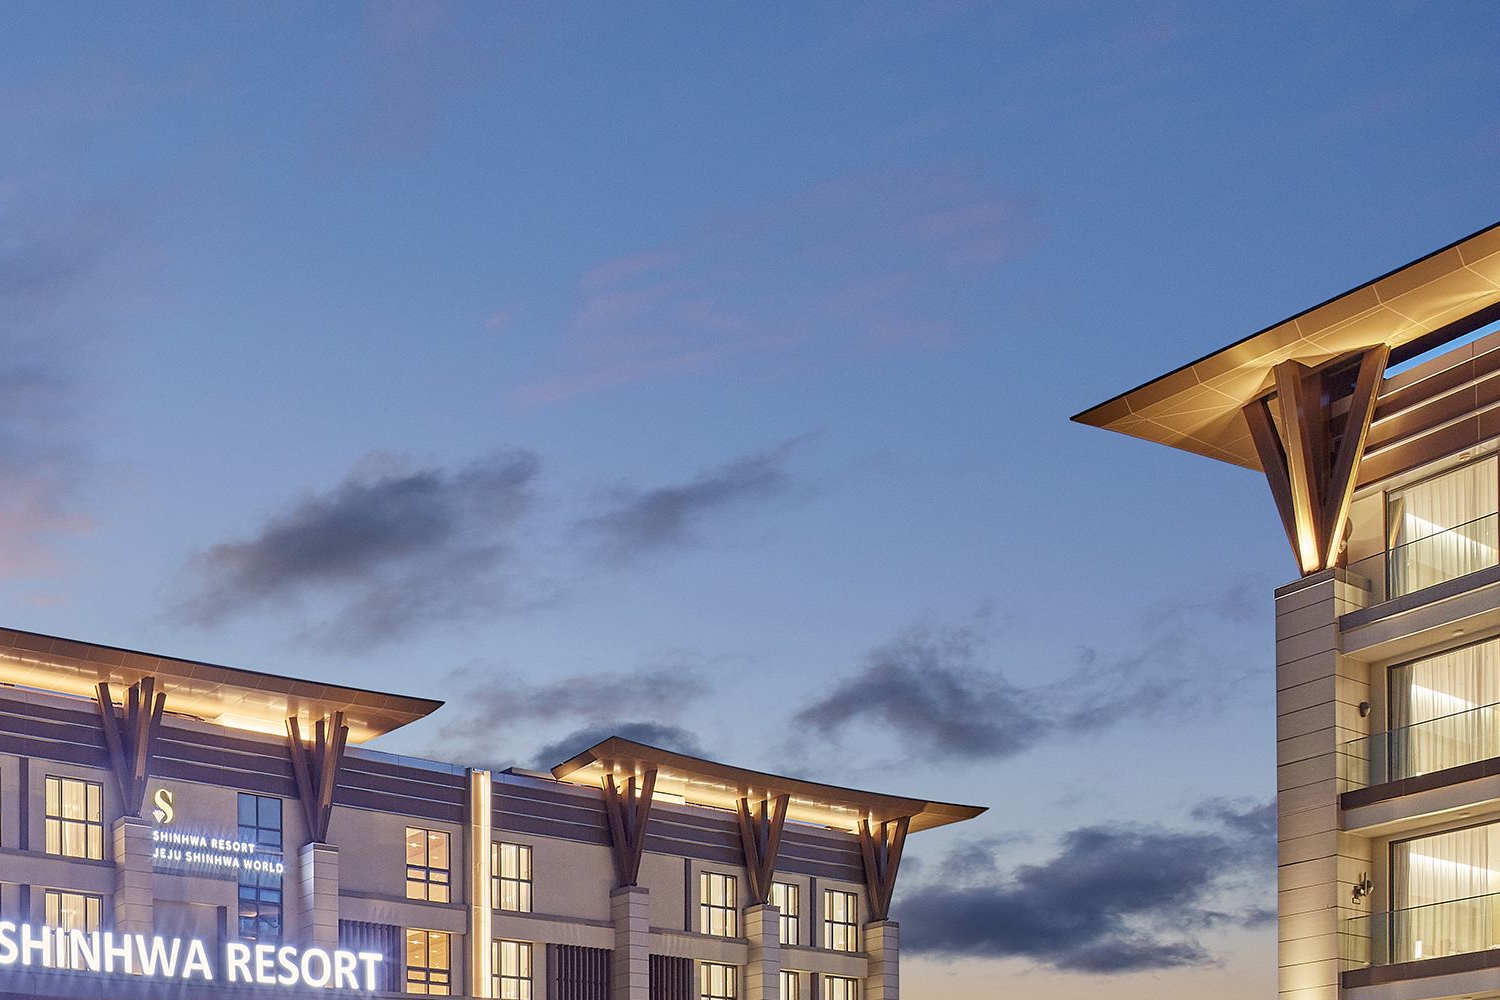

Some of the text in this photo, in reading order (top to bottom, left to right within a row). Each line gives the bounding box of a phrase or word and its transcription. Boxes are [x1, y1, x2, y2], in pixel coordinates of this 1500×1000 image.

[152, 830, 255, 854] SHINHWA RESORT
[152, 847, 284, 874] JEJU SHINHWA WORLD
[227, 943, 383, 991] RESORT
